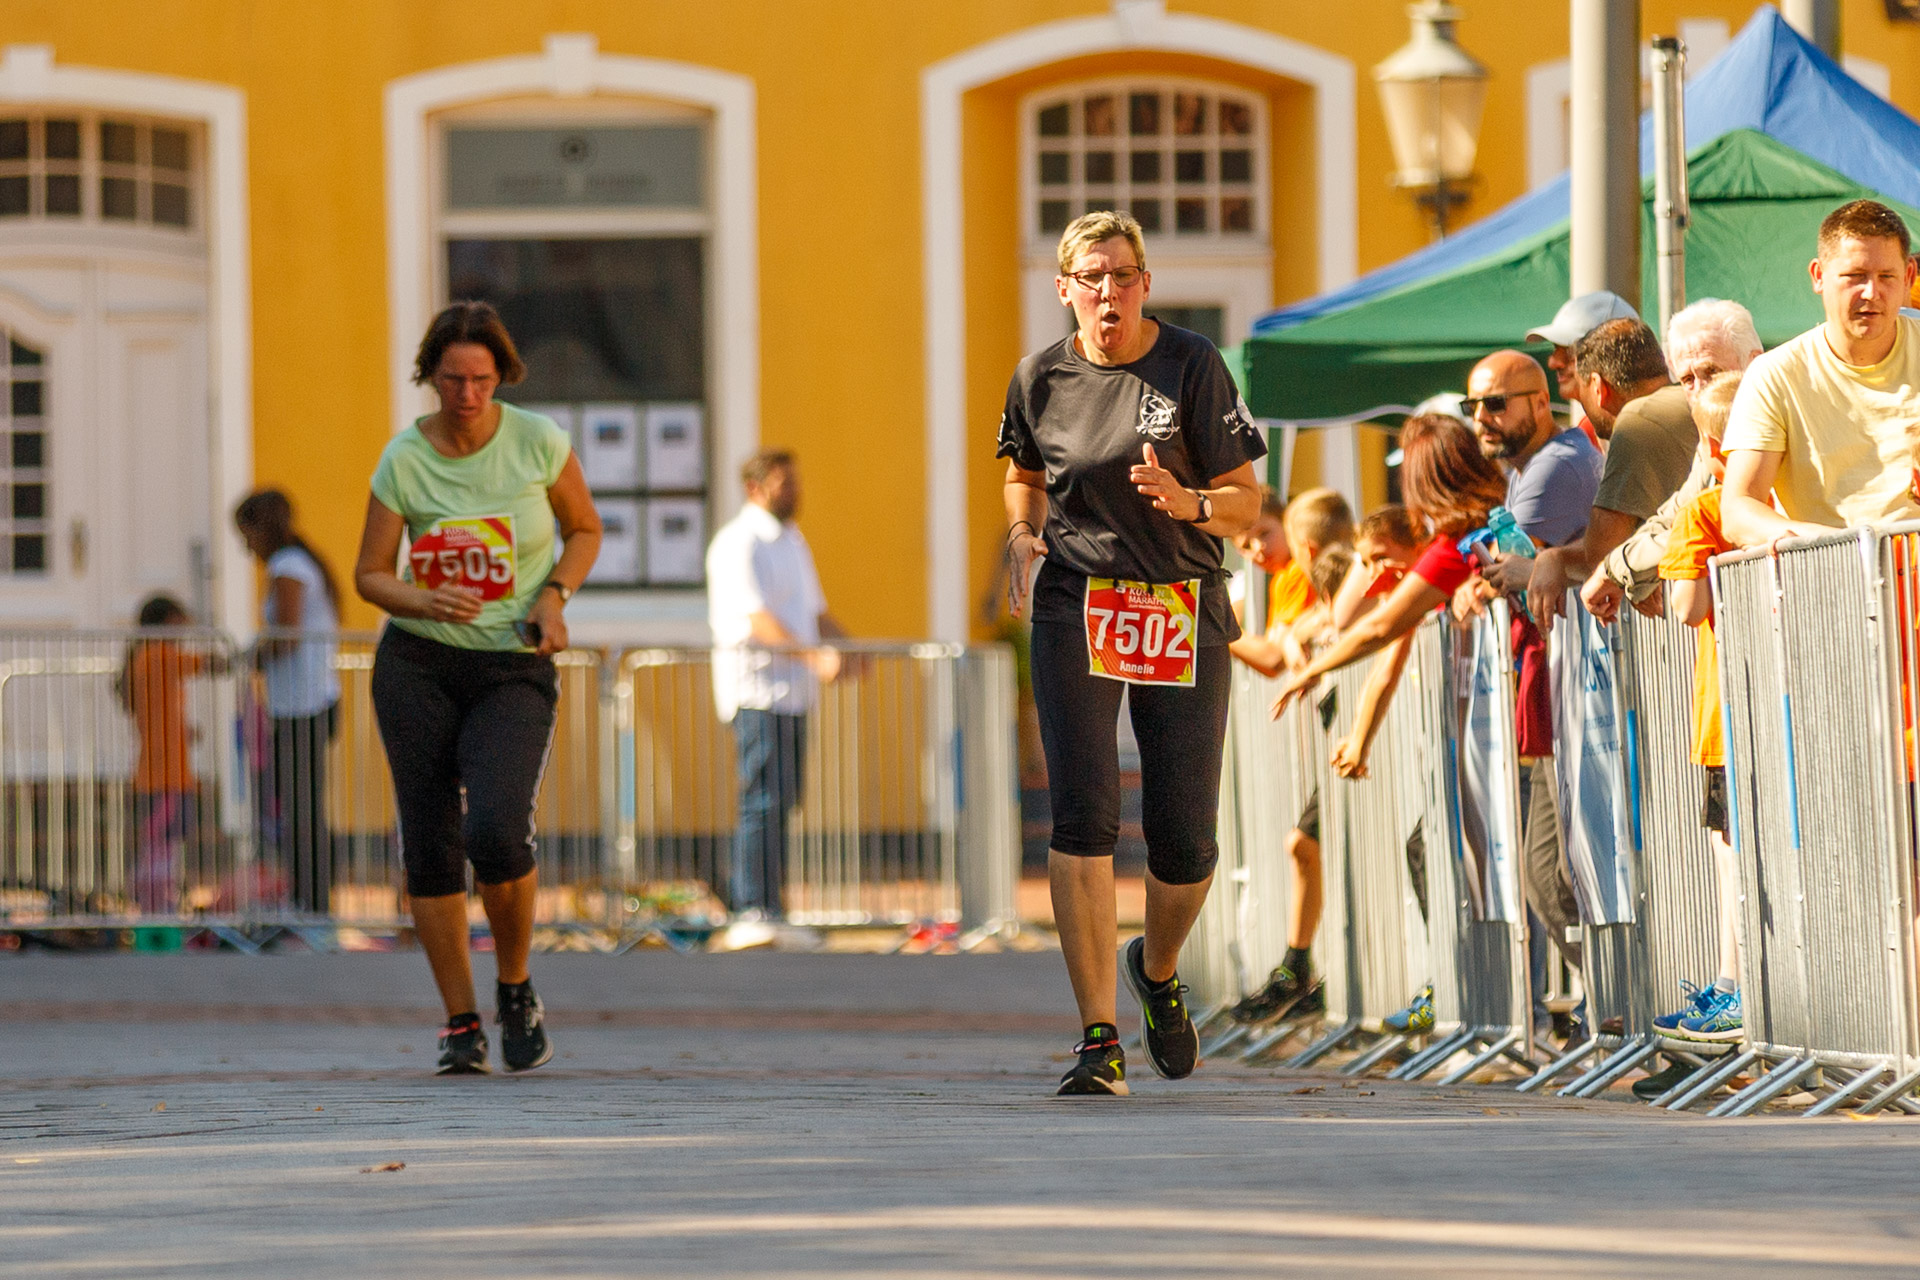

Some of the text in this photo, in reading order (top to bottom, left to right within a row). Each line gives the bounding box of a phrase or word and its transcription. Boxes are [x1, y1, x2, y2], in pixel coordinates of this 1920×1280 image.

[412, 547, 512, 585] 7505
[1128, 595, 1176, 606] MARATHON
[1089, 607, 1192, 658] 7502
[1119, 660, 1155, 674] Annelie
